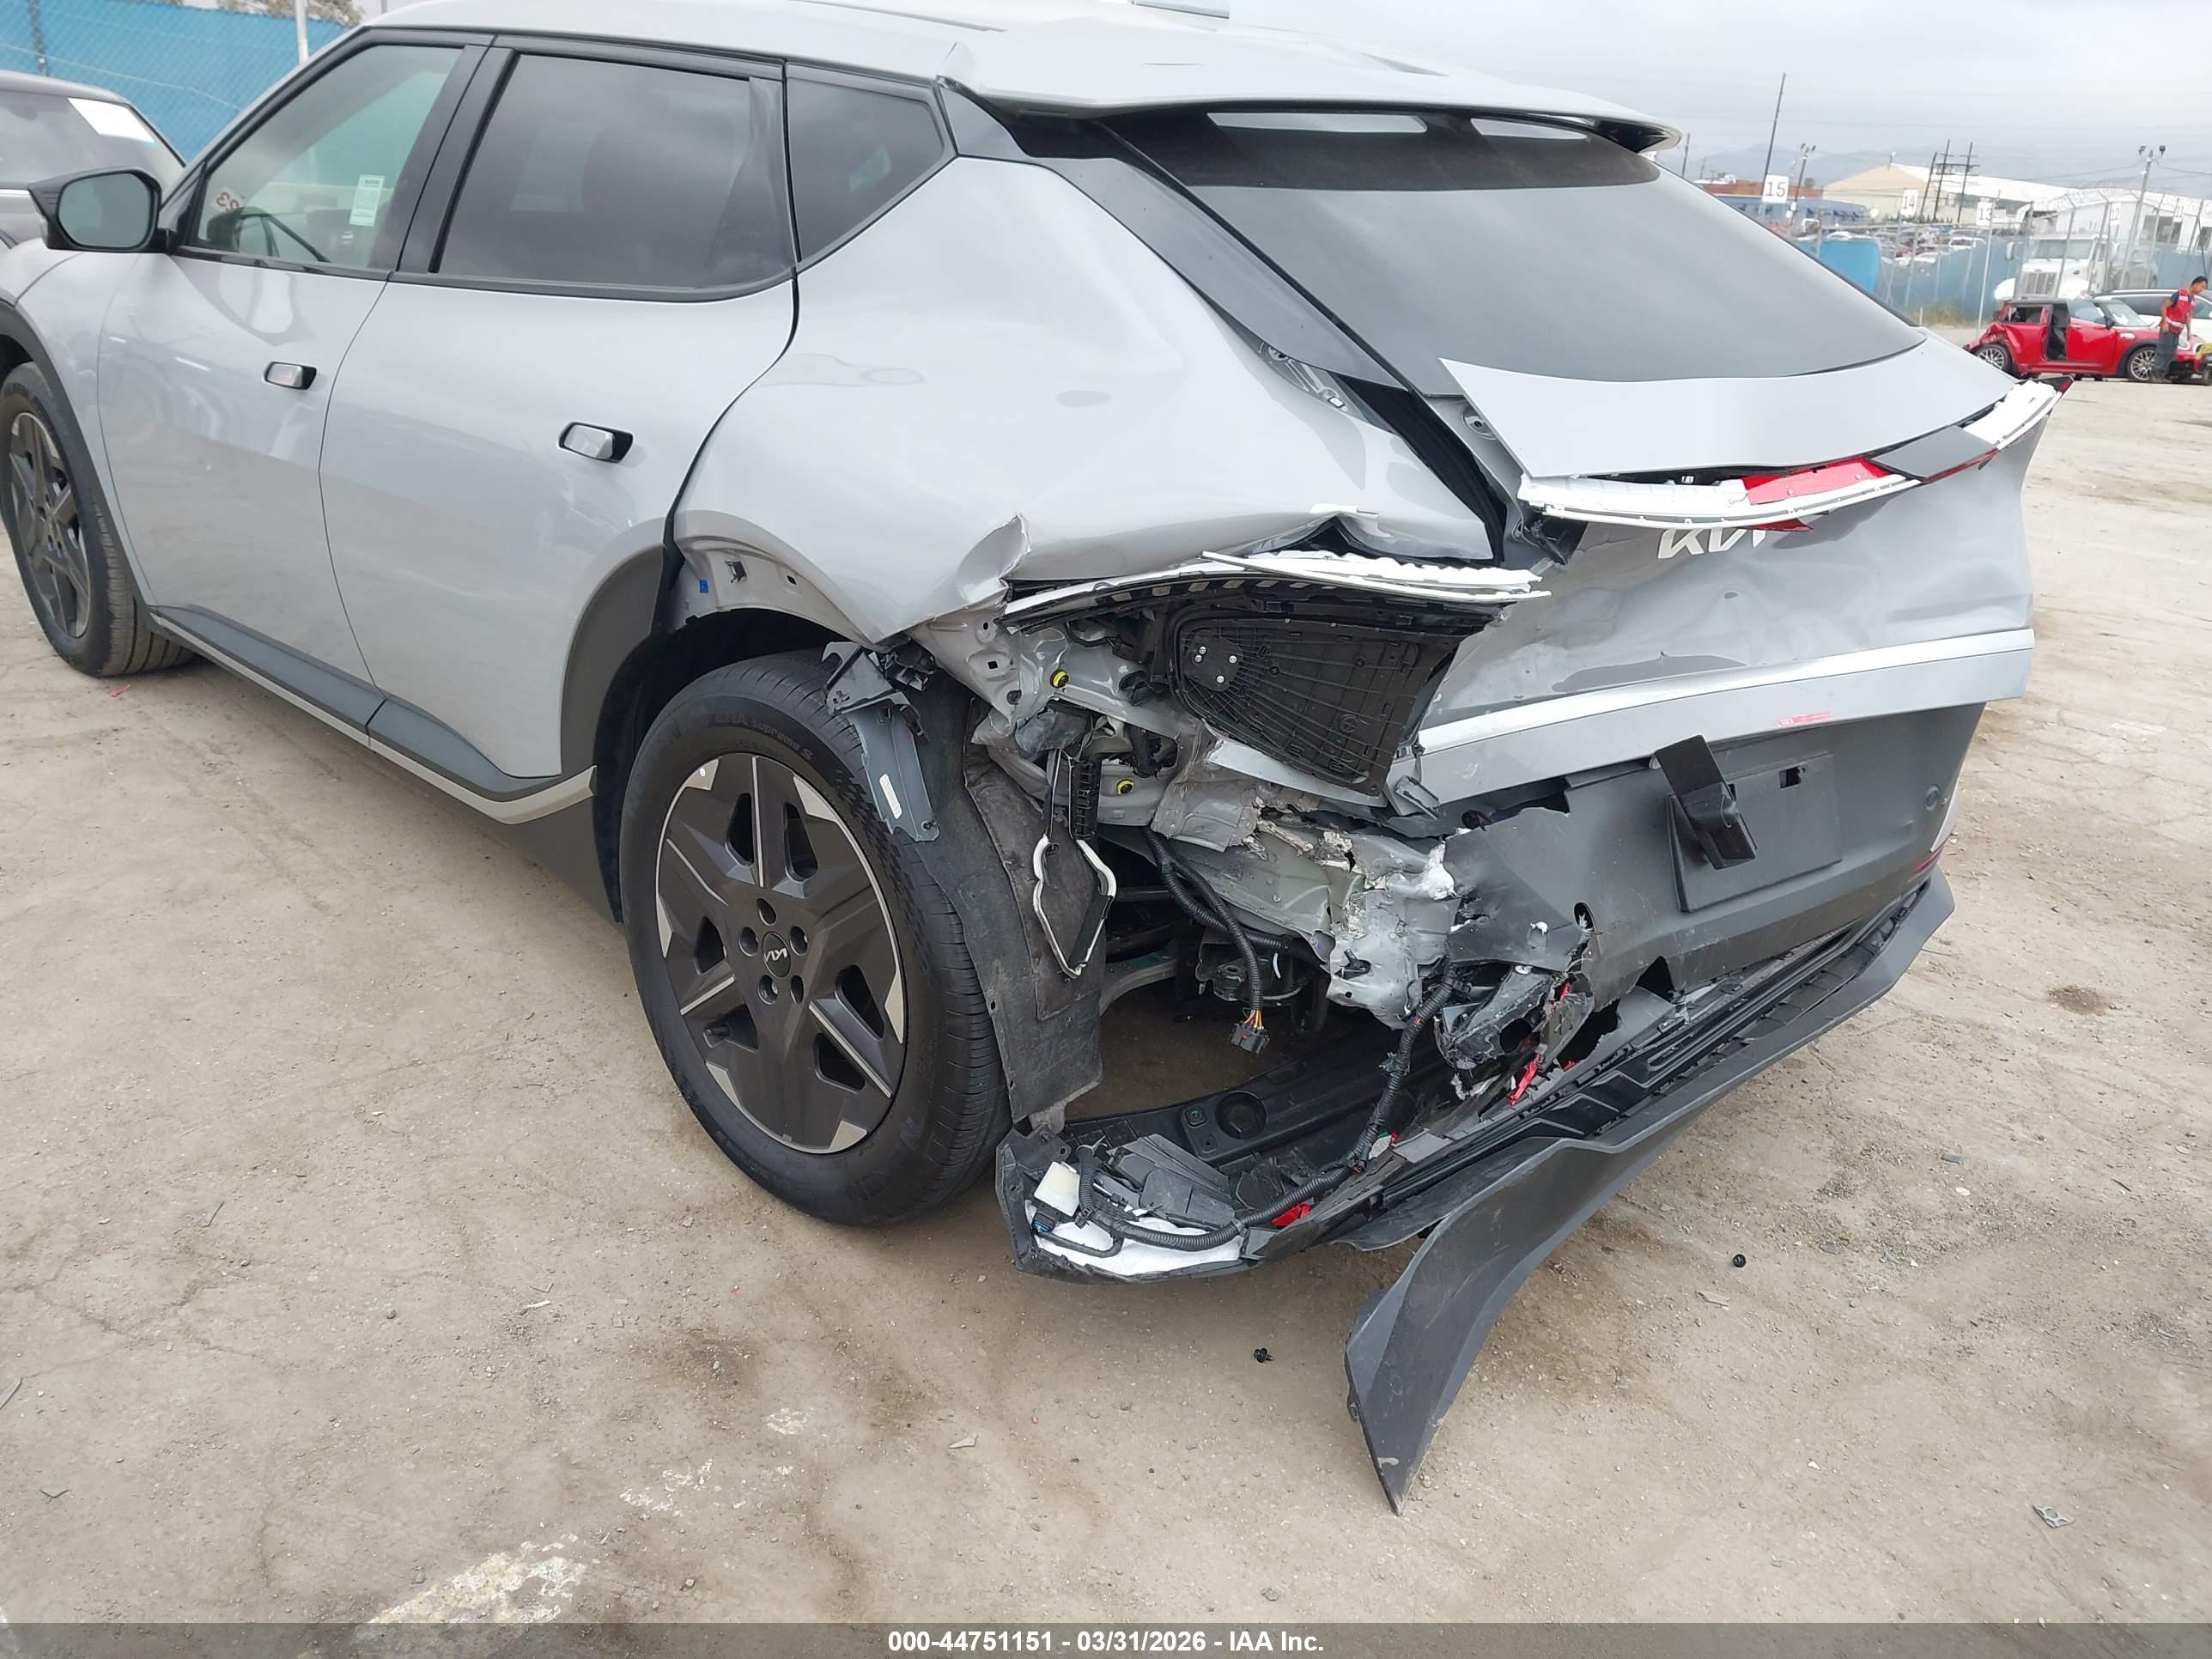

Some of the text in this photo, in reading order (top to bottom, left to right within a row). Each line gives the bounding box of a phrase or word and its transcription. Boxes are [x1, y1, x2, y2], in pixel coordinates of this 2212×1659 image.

[1765, 181, 1786, 198] 15
[1902, 195, 1916, 210] 14
[1978, 208, 1993, 221] 13
